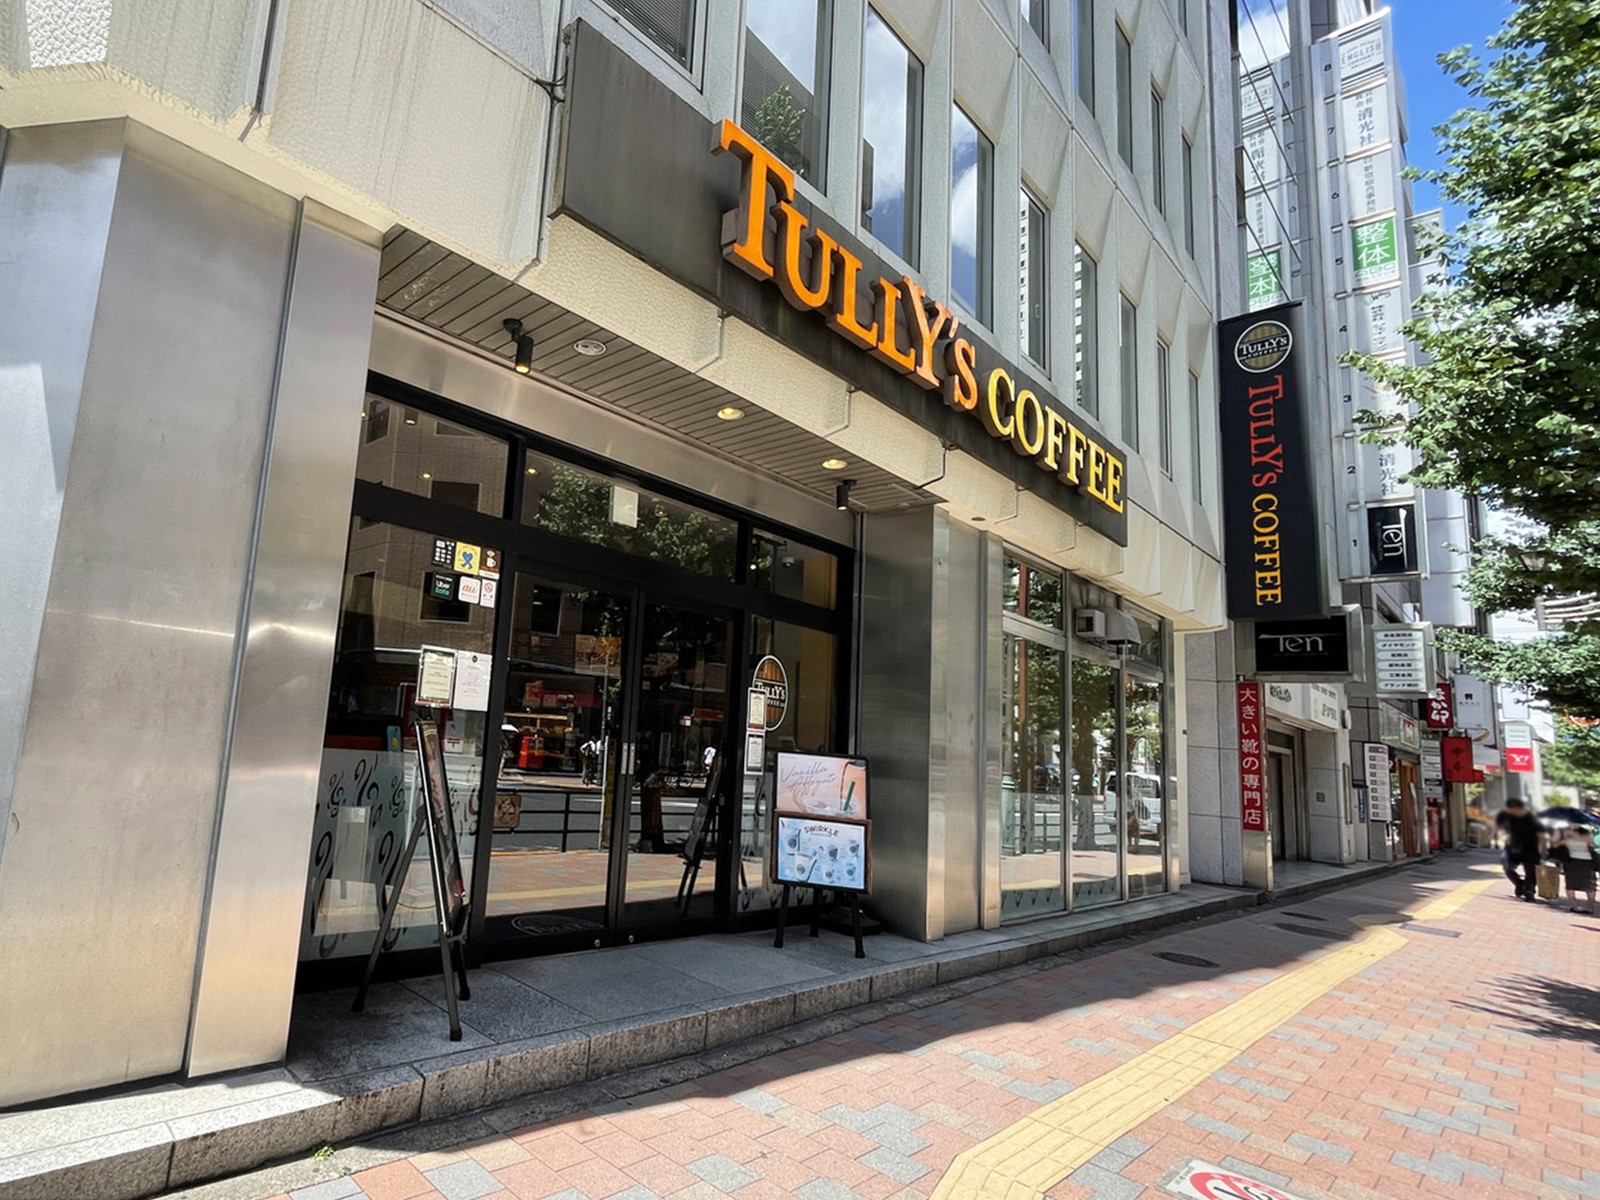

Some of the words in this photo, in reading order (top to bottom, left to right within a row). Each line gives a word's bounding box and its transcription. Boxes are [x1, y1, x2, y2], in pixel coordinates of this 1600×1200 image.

[1327, 126, 1335, 135] 7
[1331, 192, 1340, 200] 6
[1357, 222, 1391, 267] 整体
[1335, 257, 1344, 266] 5
[712, 118, 978, 412] TULLY'S
[985, 367, 1125, 515] COFFEE
[1338, 324, 1348, 333] 4
[1239, 336, 1287, 355] TULLY'S
[1342, 394, 1352, 403] 3
[1247, 375, 1284, 488] TULLY'S
[1346, 466, 1356, 475] 2
[1251, 493, 1283, 606] COFFEE
[435, 580, 451, 589] Uber
[462, 584, 478, 593] au
[1239, 688, 1263, 826] 大きい靴の専門店
